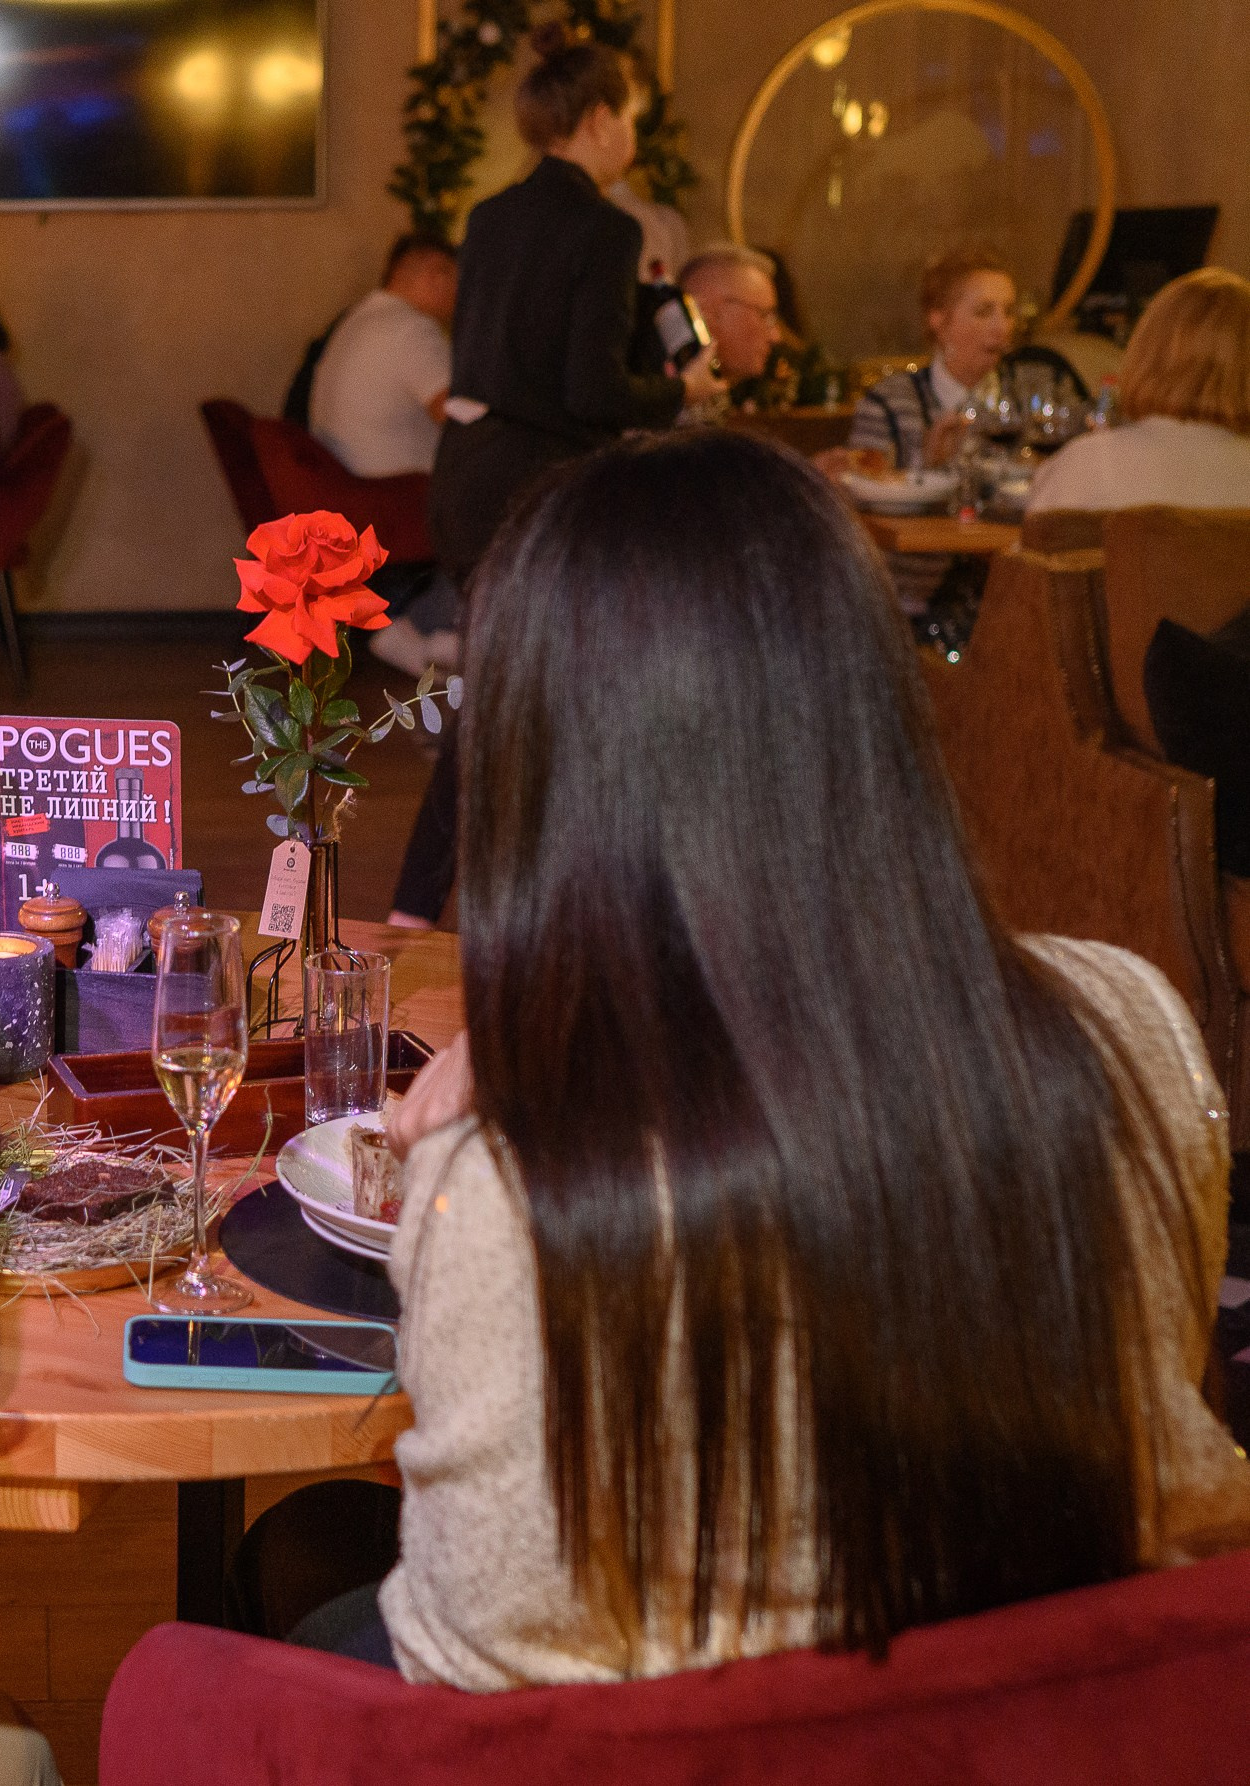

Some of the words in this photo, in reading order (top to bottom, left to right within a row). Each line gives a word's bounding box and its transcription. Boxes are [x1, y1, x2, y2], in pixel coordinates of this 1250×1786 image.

[28, 739, 48, 750] THE
[0, 765, 107, 794] ТРЕТИЙ
[0, 795, 35, 817] НЕ
